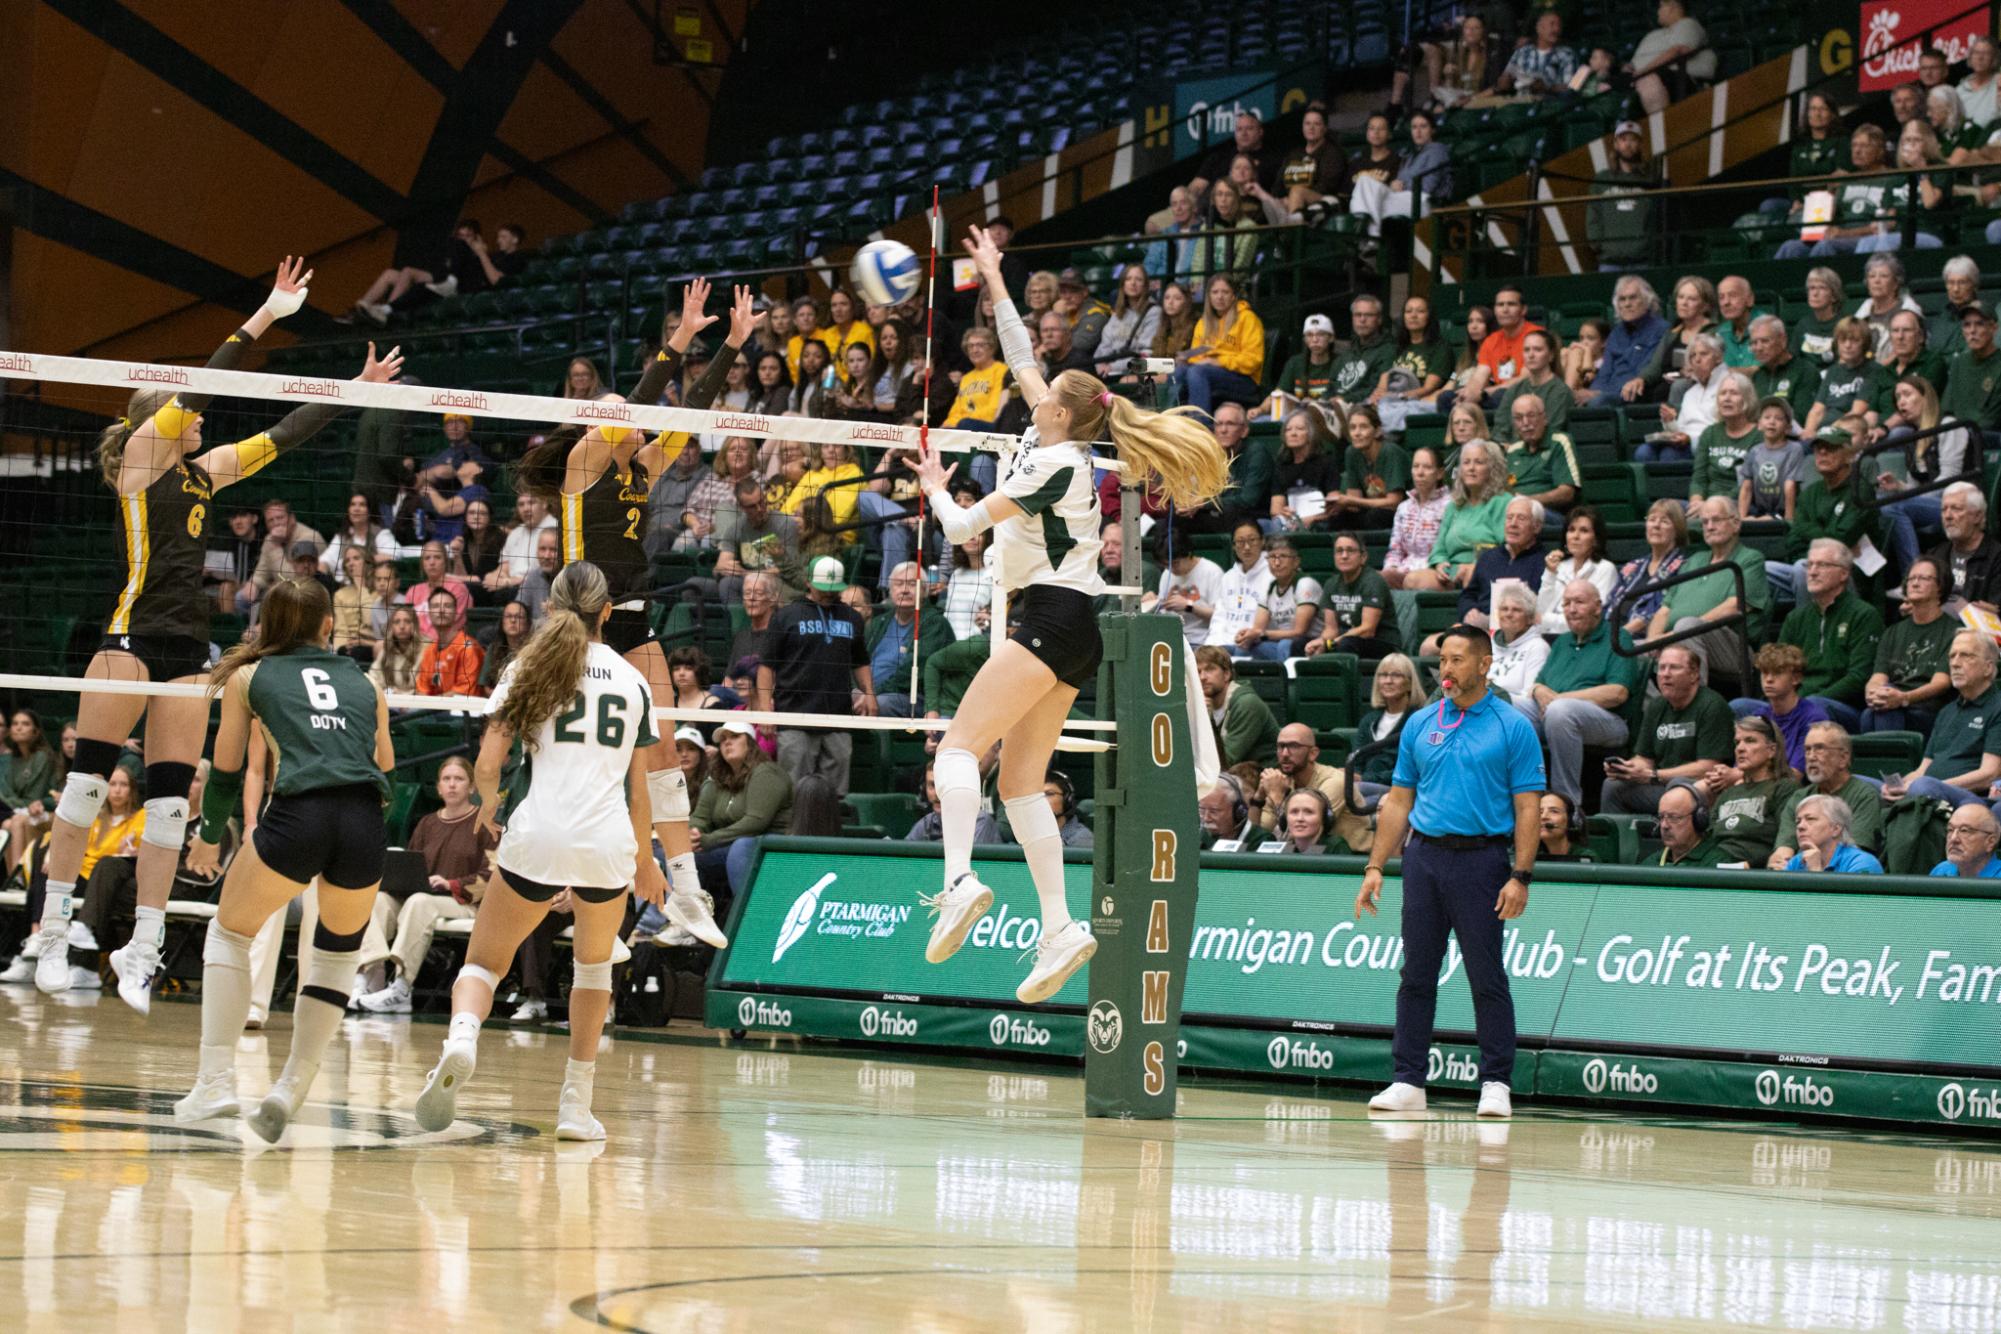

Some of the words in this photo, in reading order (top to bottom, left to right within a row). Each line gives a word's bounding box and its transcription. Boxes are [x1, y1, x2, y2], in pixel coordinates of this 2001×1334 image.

[1820, 29, 1853, 76] G
[1145, 105, 1168, 149] H
[0, 355, 31, 371] ealth
[128, 365, 188, 384] uchealth
[282, 379, 340, 397] uchealth
[432, 391, 487, 409] uchealth
[576, 404, 631, 421] uchealth
[716, 415, 769, 432] uchealth
[852, 425, 903, 442] uchealth
[187, 504, 205, 538] 6
[626, 507, 640, 540] 2
[583, 667, 612, 681] RUN
[302, 668, 338, 711] 6
[311, 714, 347, 731] DOTY
[553, 690, 627, 748] 26
[820, 901, 912, 924] PTARMIGAN
[817, 918, 863, 939] Country
[865, 922, 895, 938] Club
[1189, 918, 1314, 974] rmigan
[1322, 921, 1463, 987] Couy
[1502, 927, 1564, 979] lub
[1597, 935, 1690, 986] Golf
[1687, 946, 1731, 988] at
[1736, 942, 1788, 992] Its
[1794, 944, 1904, 1005] Peak,
[883, 993, 919, 1001] DAKTRONICS
[757, 1002, 791, 1027] fnbo
[880, 1011, 917, 1036] fnbo
[1292, 1020, 1334, 1030] DAKTRONICS
[1010, 1019, 1049, 1046] fnbo
[1291, 1041, 1333, 1070] fnbo
[1446, 1053, 1479, 1082] fnb
[1778, 1054, 1828, 1065] DAKTRONICS
[1609, 1064, 1658, 1094] fnbo
[1783, 1074, 1834, 1107] fnbo
